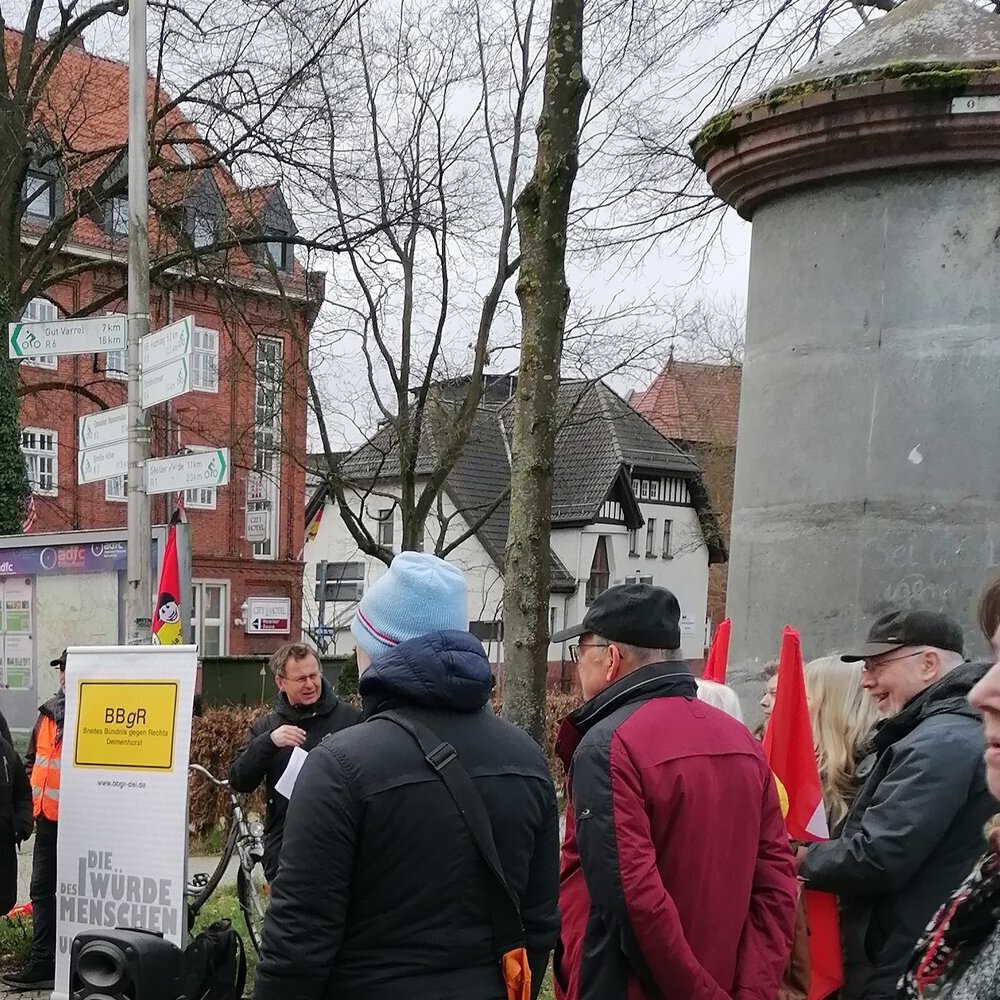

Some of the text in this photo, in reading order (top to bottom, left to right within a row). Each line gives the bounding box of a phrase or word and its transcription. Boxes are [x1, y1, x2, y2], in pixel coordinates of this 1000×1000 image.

[45, 327, 59, 337] Gut
[61, 326, 85, 335] Varrel
[57, 546, 85, 561] adfc
[105, 707, 147, 729] BBgR
[83, 727, 103, 735] Breites
[104, 727, 127, 735] Bündnis
[148, 728, 168, 737] Rechts
[88, 850, 113, 870] DIE
[60, 882, 77, 895] DES
[89, 868, 172, 906] WÜRDE
[60, 896, 178, 935] MENSCHEN
